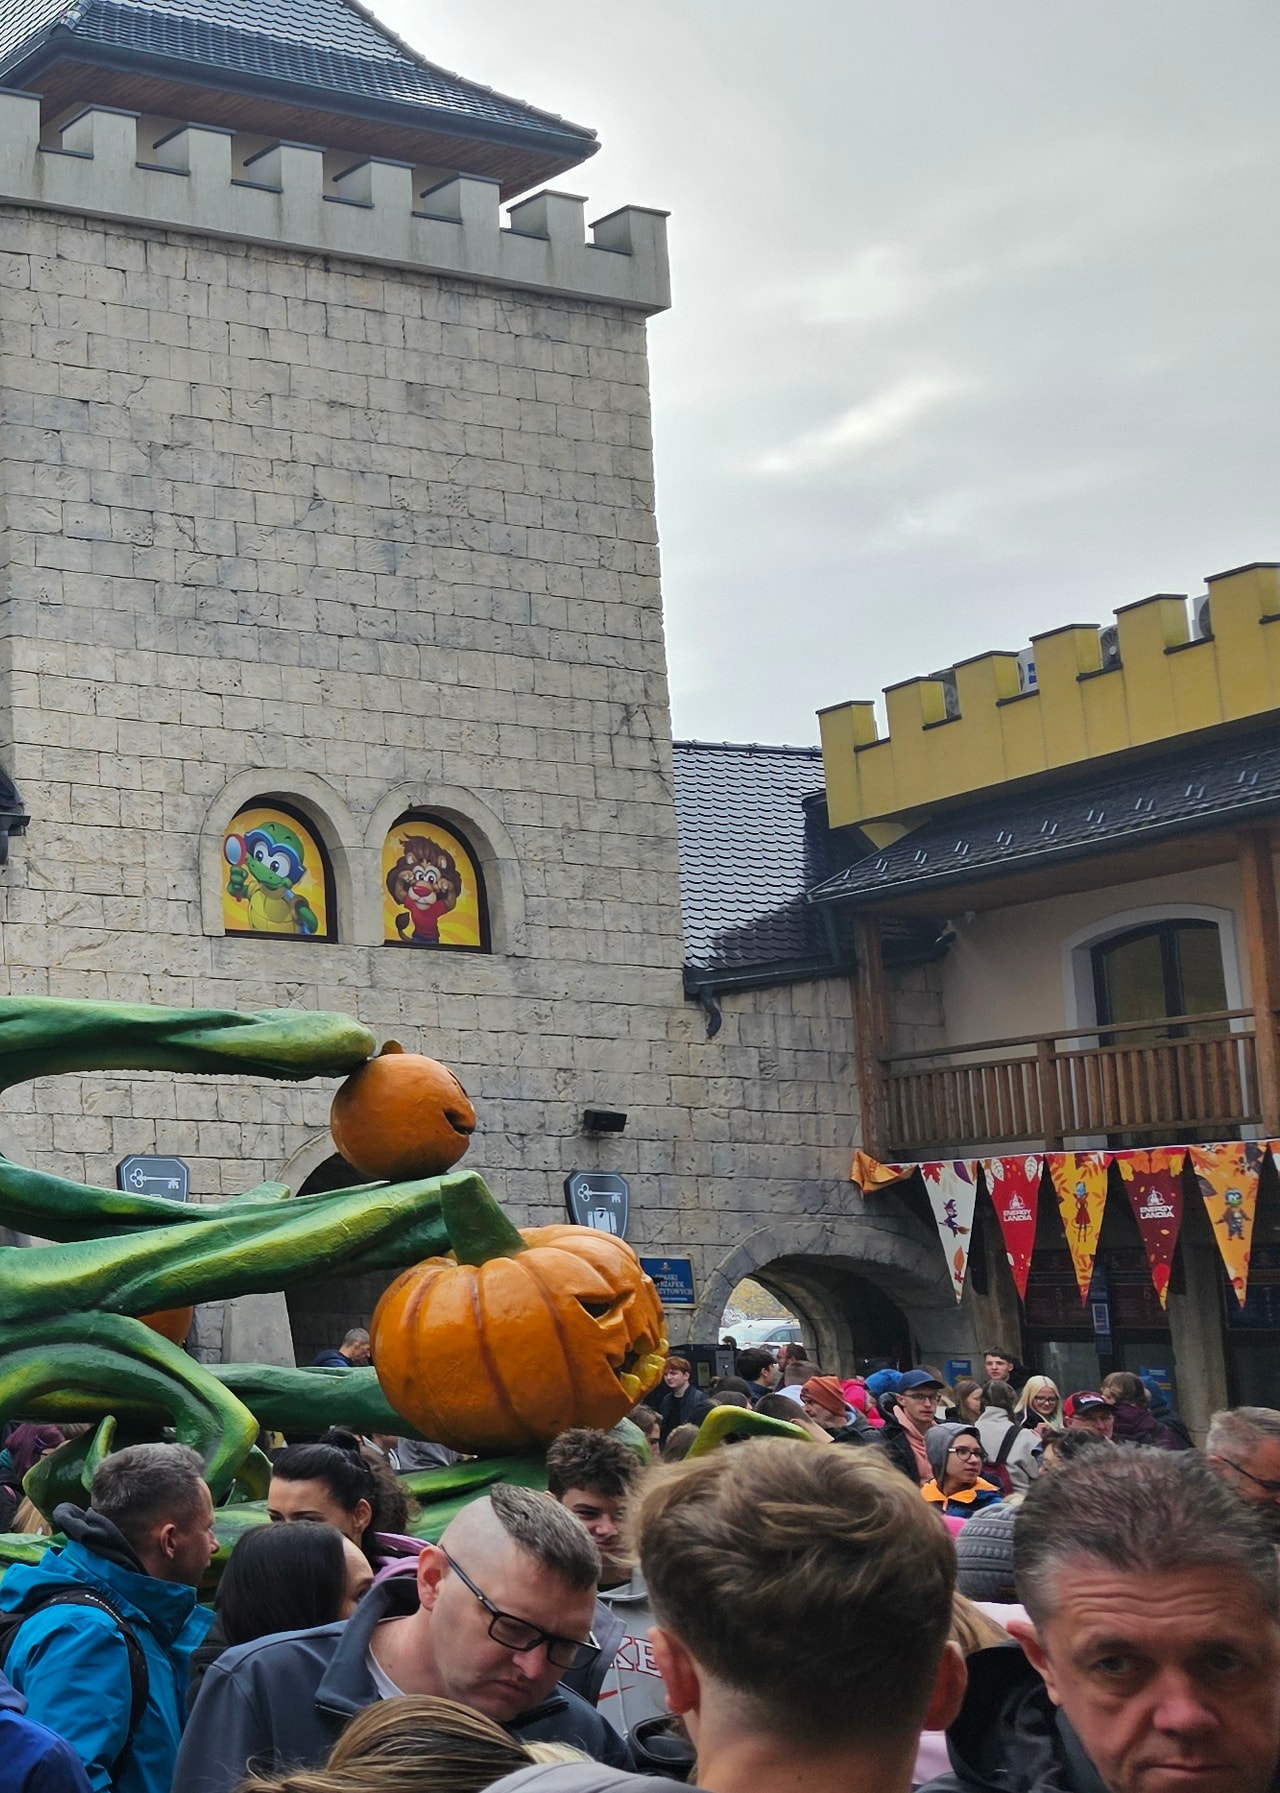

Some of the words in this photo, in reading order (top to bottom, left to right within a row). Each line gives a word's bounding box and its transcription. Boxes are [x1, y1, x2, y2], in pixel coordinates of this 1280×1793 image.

[1139, 1205, 1174, 1213] ENERGY
[1003, 1214, 1032, 1222] LANDIA
[1140, 1211, 1175, 1219] LANDIA
